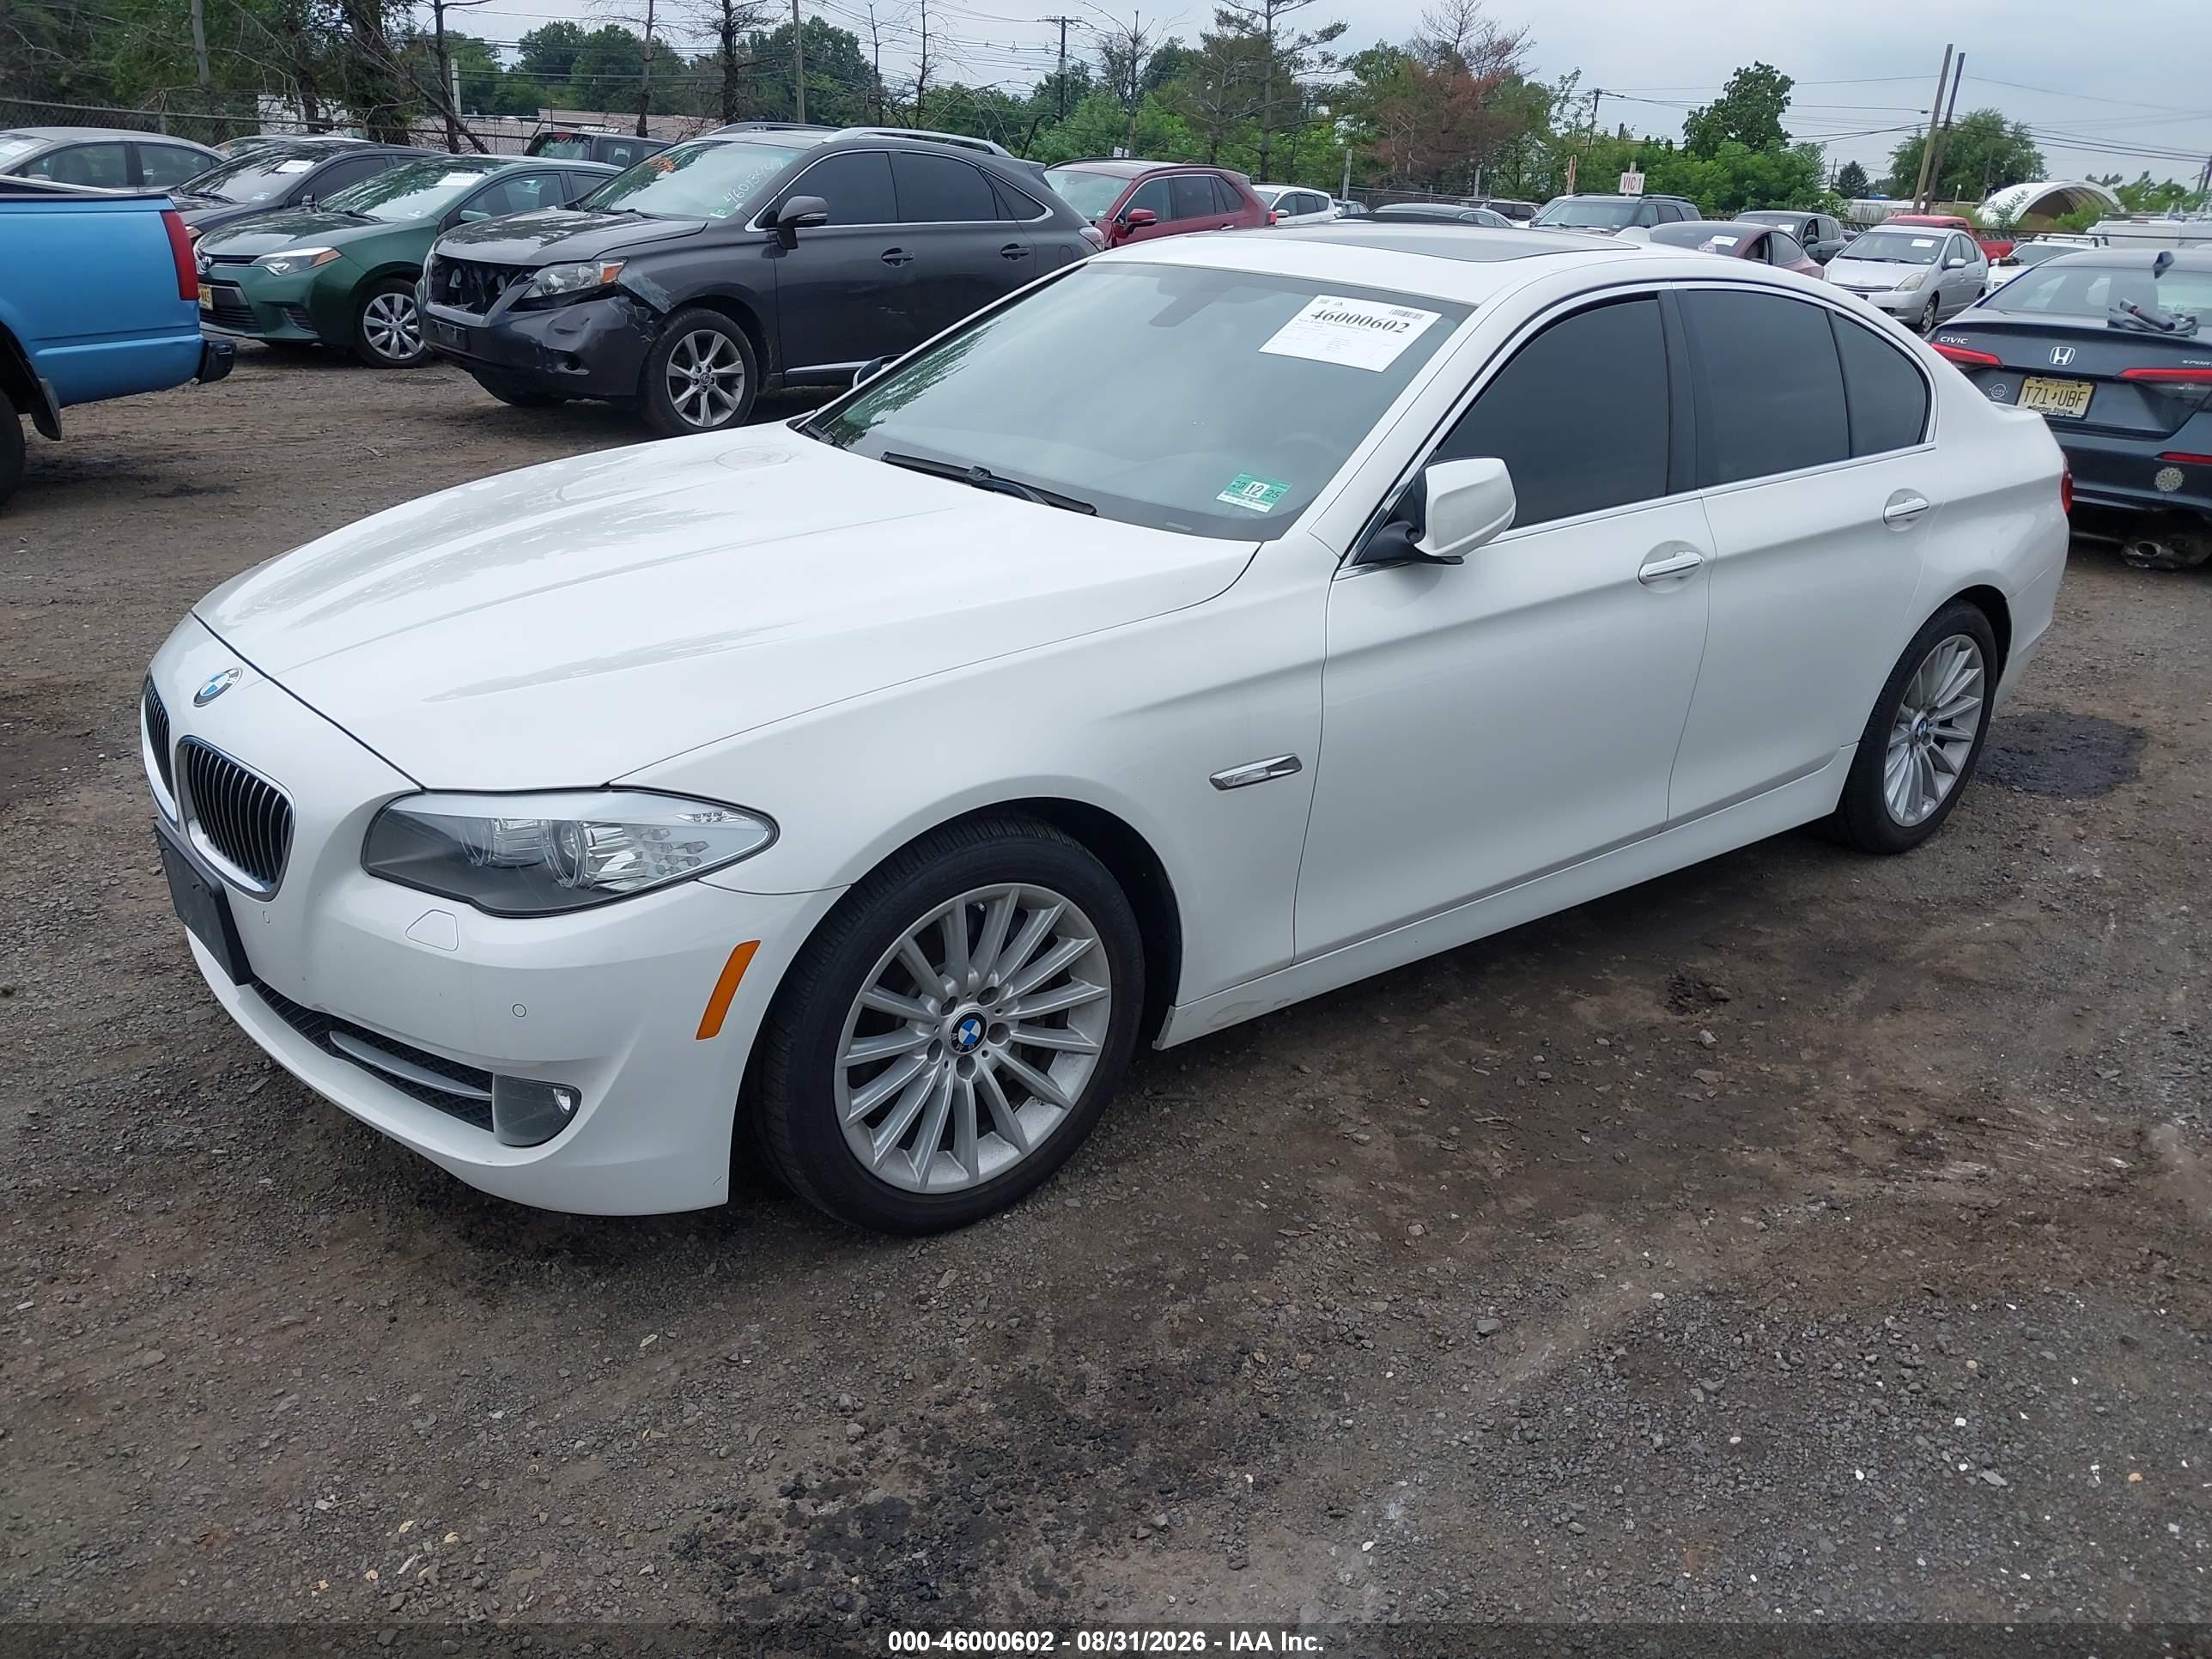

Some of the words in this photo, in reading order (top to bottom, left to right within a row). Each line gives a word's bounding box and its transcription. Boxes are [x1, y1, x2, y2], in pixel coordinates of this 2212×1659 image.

[1623, 176, 1636, 190] VIC
[1310, 308, 1411, 333] 46000602
[1940, 336, 1969, 344] CIVIC
[1231, 480, 1247, 489] 20
[1245, 483, 1265, 496] 12
[1265, 489, 1281, 499] 25
